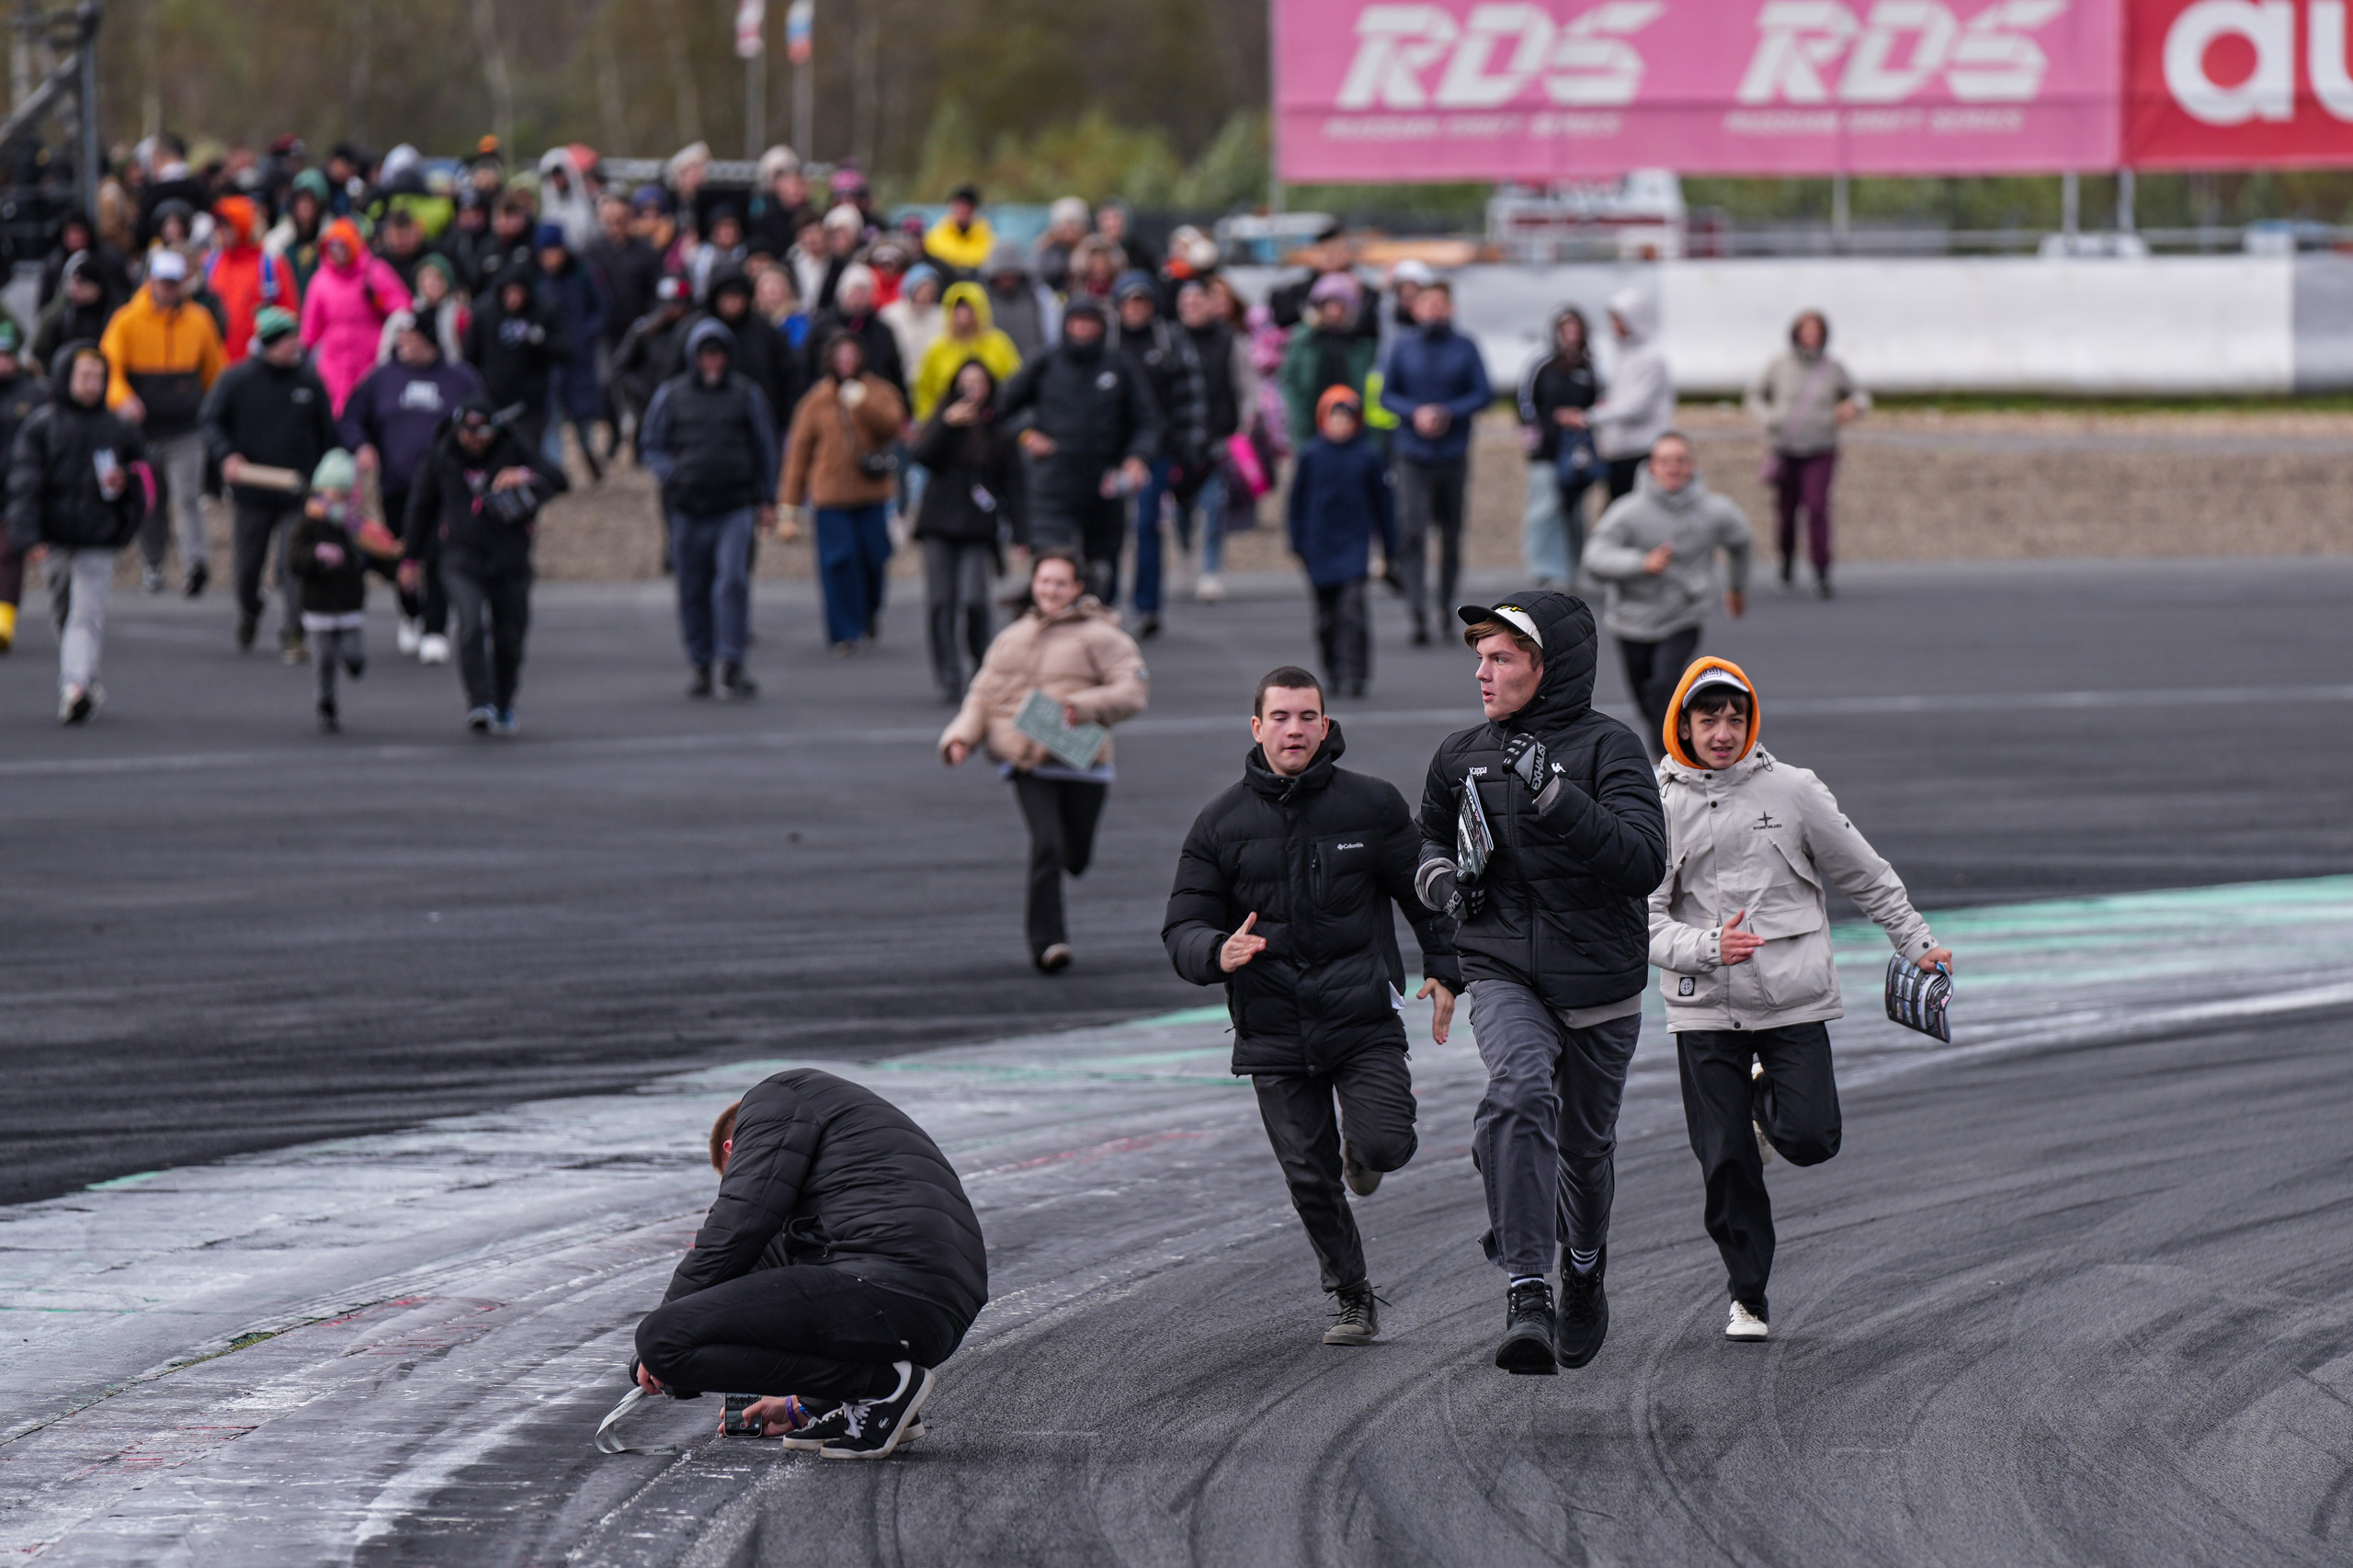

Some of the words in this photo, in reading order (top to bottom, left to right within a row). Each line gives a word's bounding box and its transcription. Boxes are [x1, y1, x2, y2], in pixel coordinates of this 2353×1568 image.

[1336, 1, 1664, 108] RDS
[1737, 0, 2068, 105] RDS
[1469, 767, 1487, 776] Kappa
[1530, 742, 1546, 790] EXHAUST
